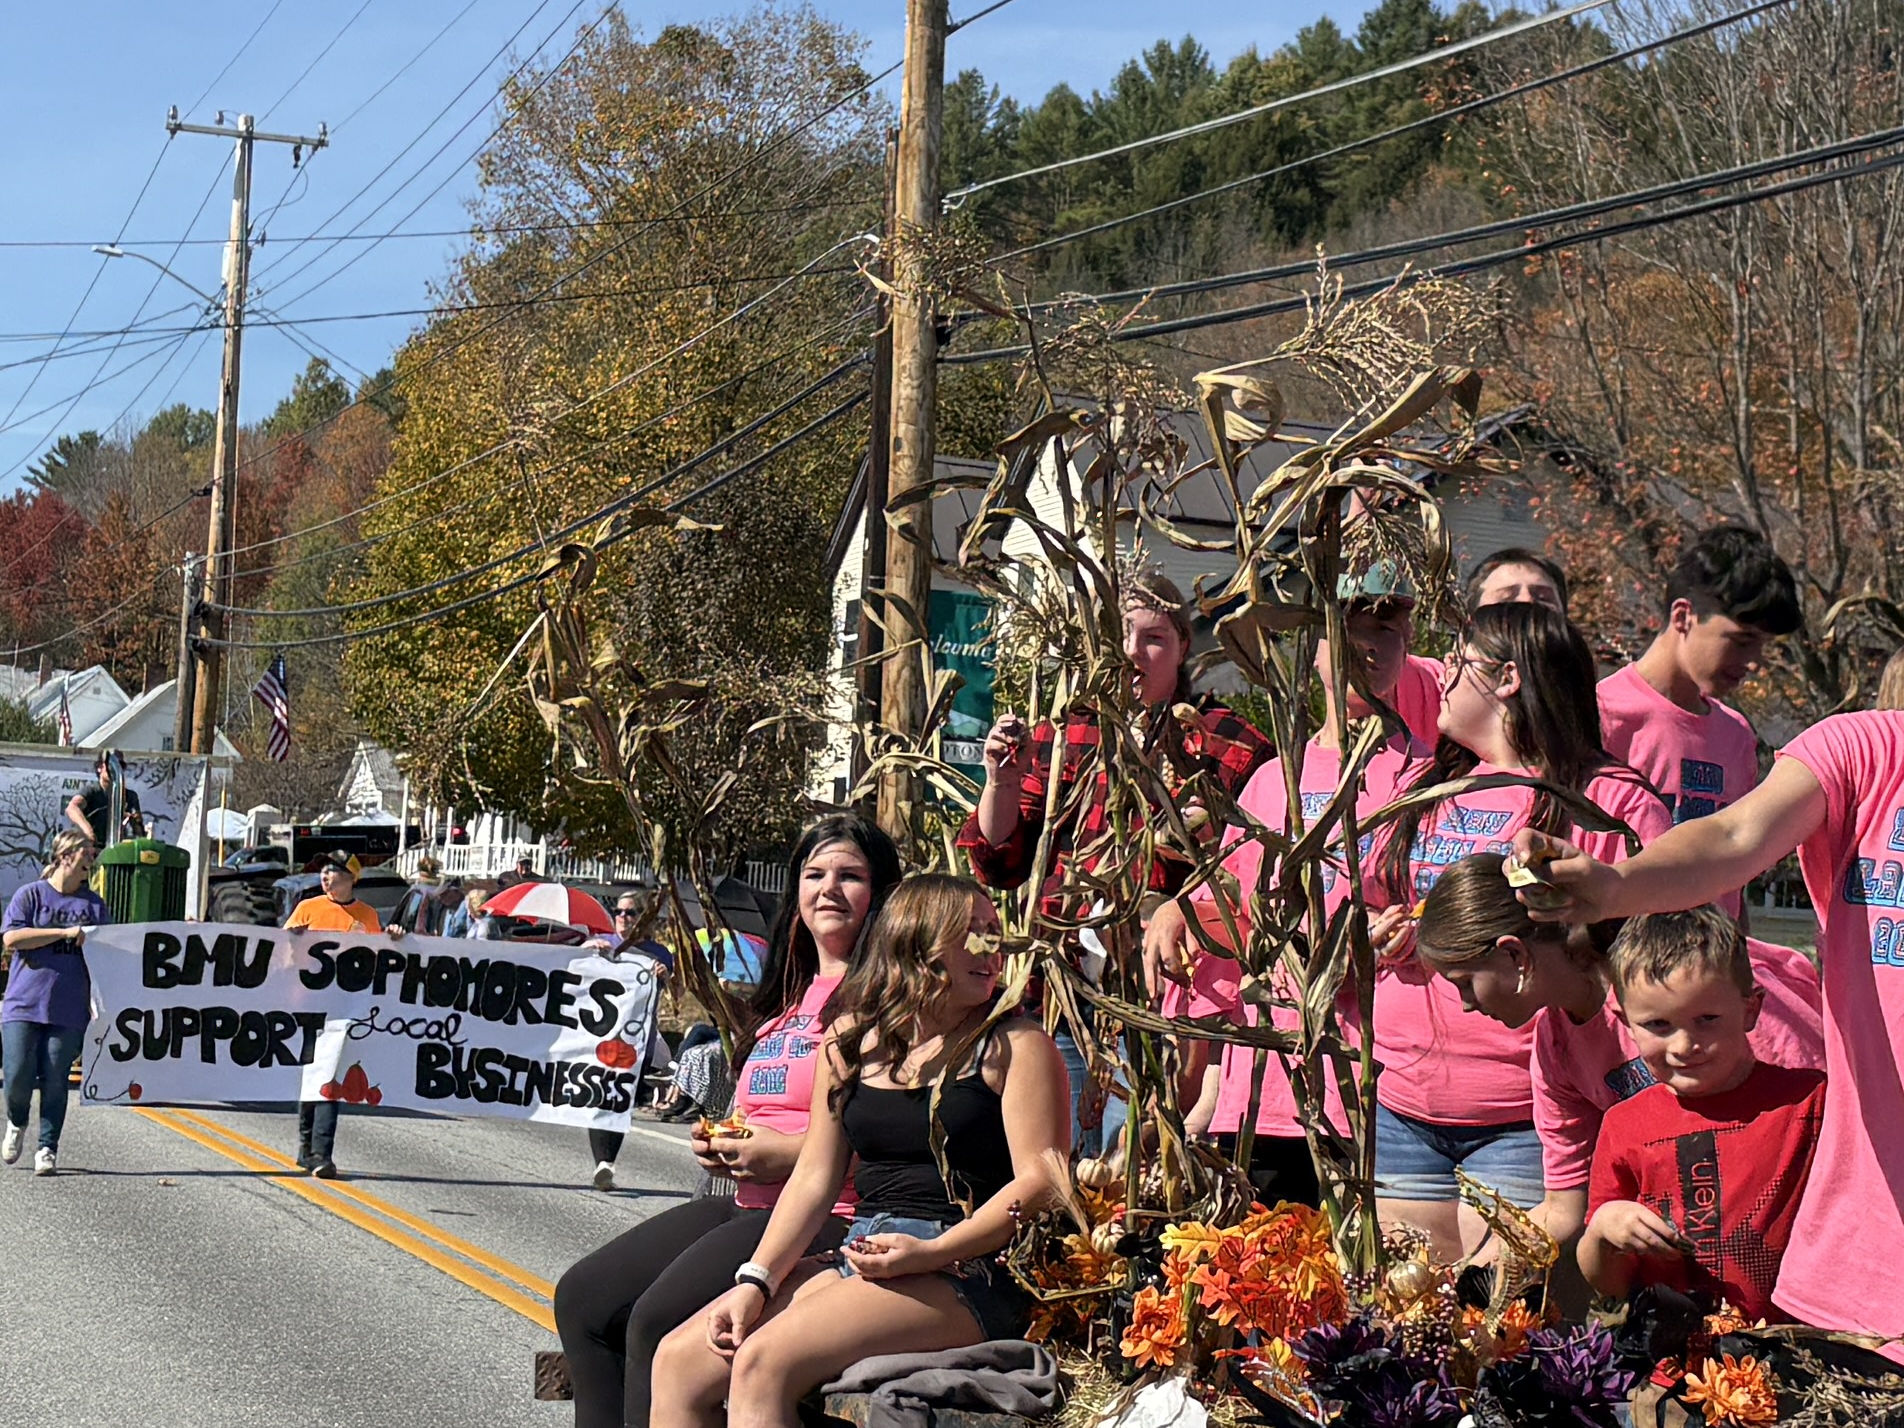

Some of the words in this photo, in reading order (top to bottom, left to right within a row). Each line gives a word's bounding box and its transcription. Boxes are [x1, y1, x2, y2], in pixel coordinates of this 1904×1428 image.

[142, 932, 275, 988] BMU
[299, 941, 626, 1037] SOPHOMORES
[109, 1006, 327, 1068] SUPPORT
[415, 1043, 636, 1113] BUSINESSES
